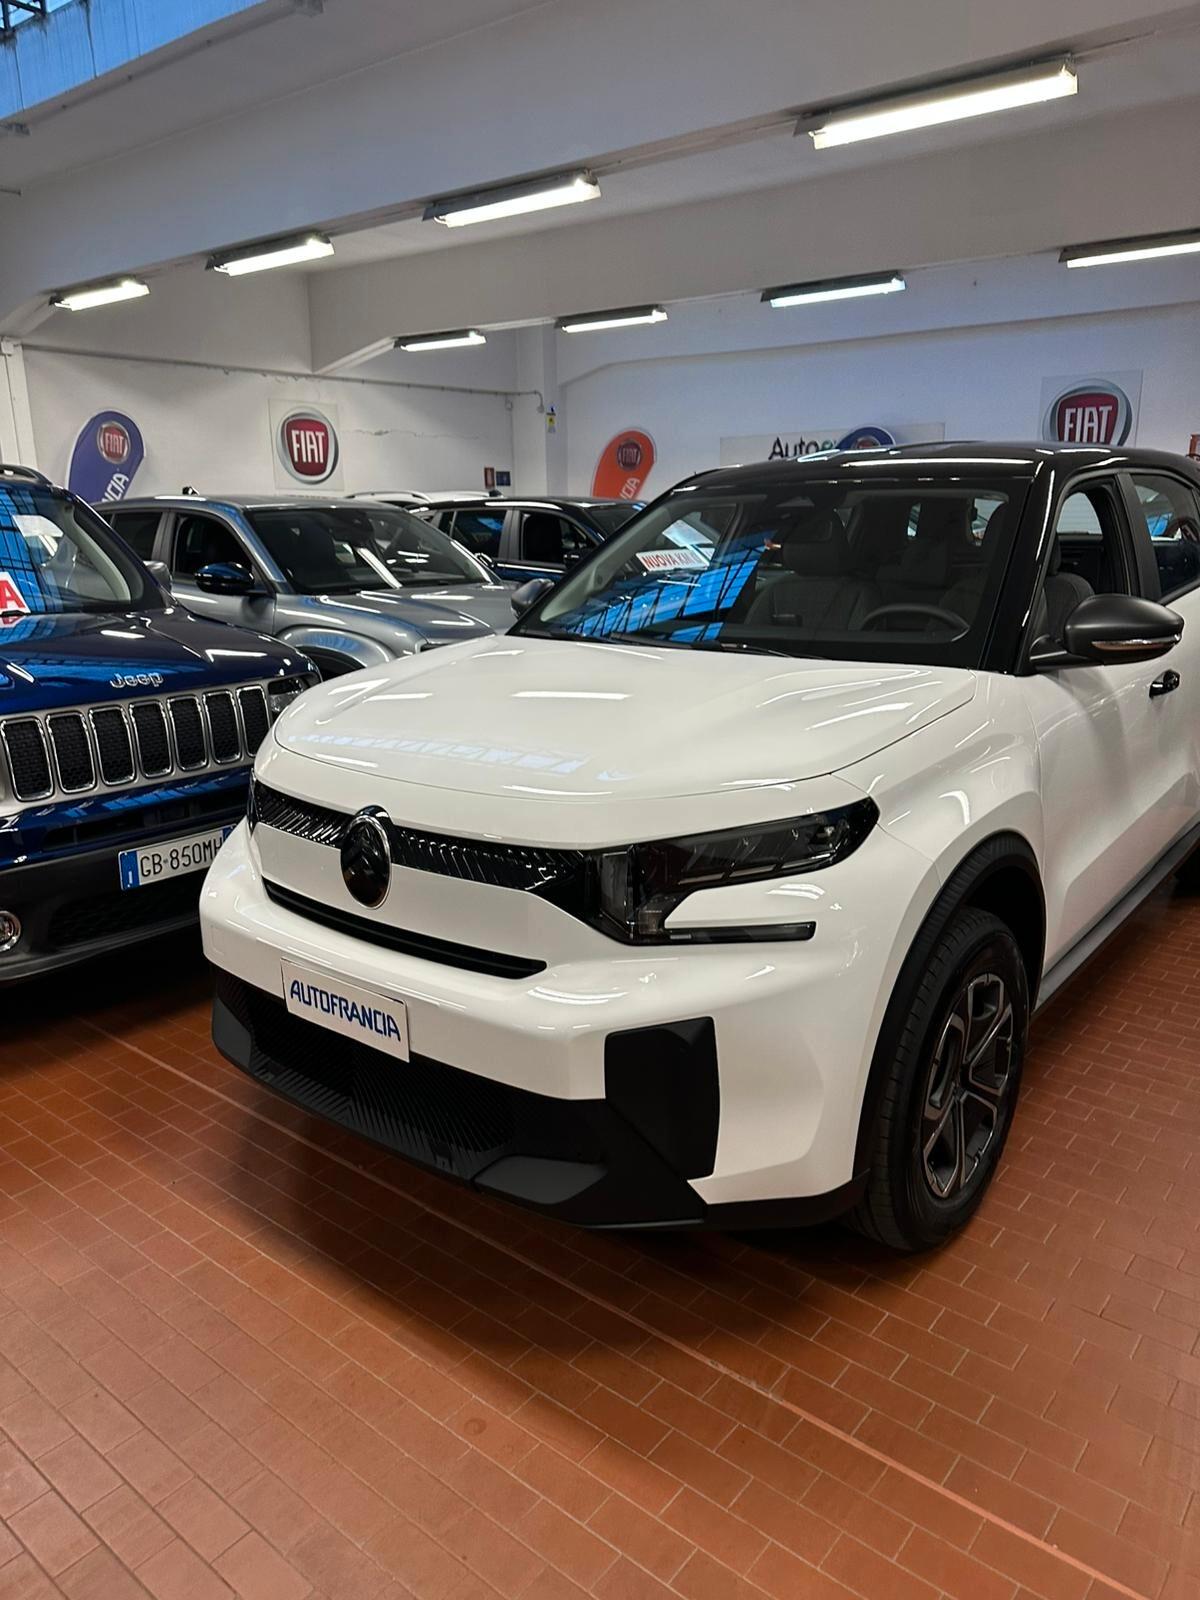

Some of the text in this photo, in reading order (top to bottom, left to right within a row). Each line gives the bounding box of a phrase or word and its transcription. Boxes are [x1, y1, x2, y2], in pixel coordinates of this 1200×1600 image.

[1063, 405, 1113, 443] FIAT
[104, 432, 125, 455] FIAT
[291, 429, 325, 463] FIAT
[641, 553, 677, 569] NUOVA
[110, 672, 164, 688] Jeep
[290, 980, 401, 1042] AUTOFRANCIA
